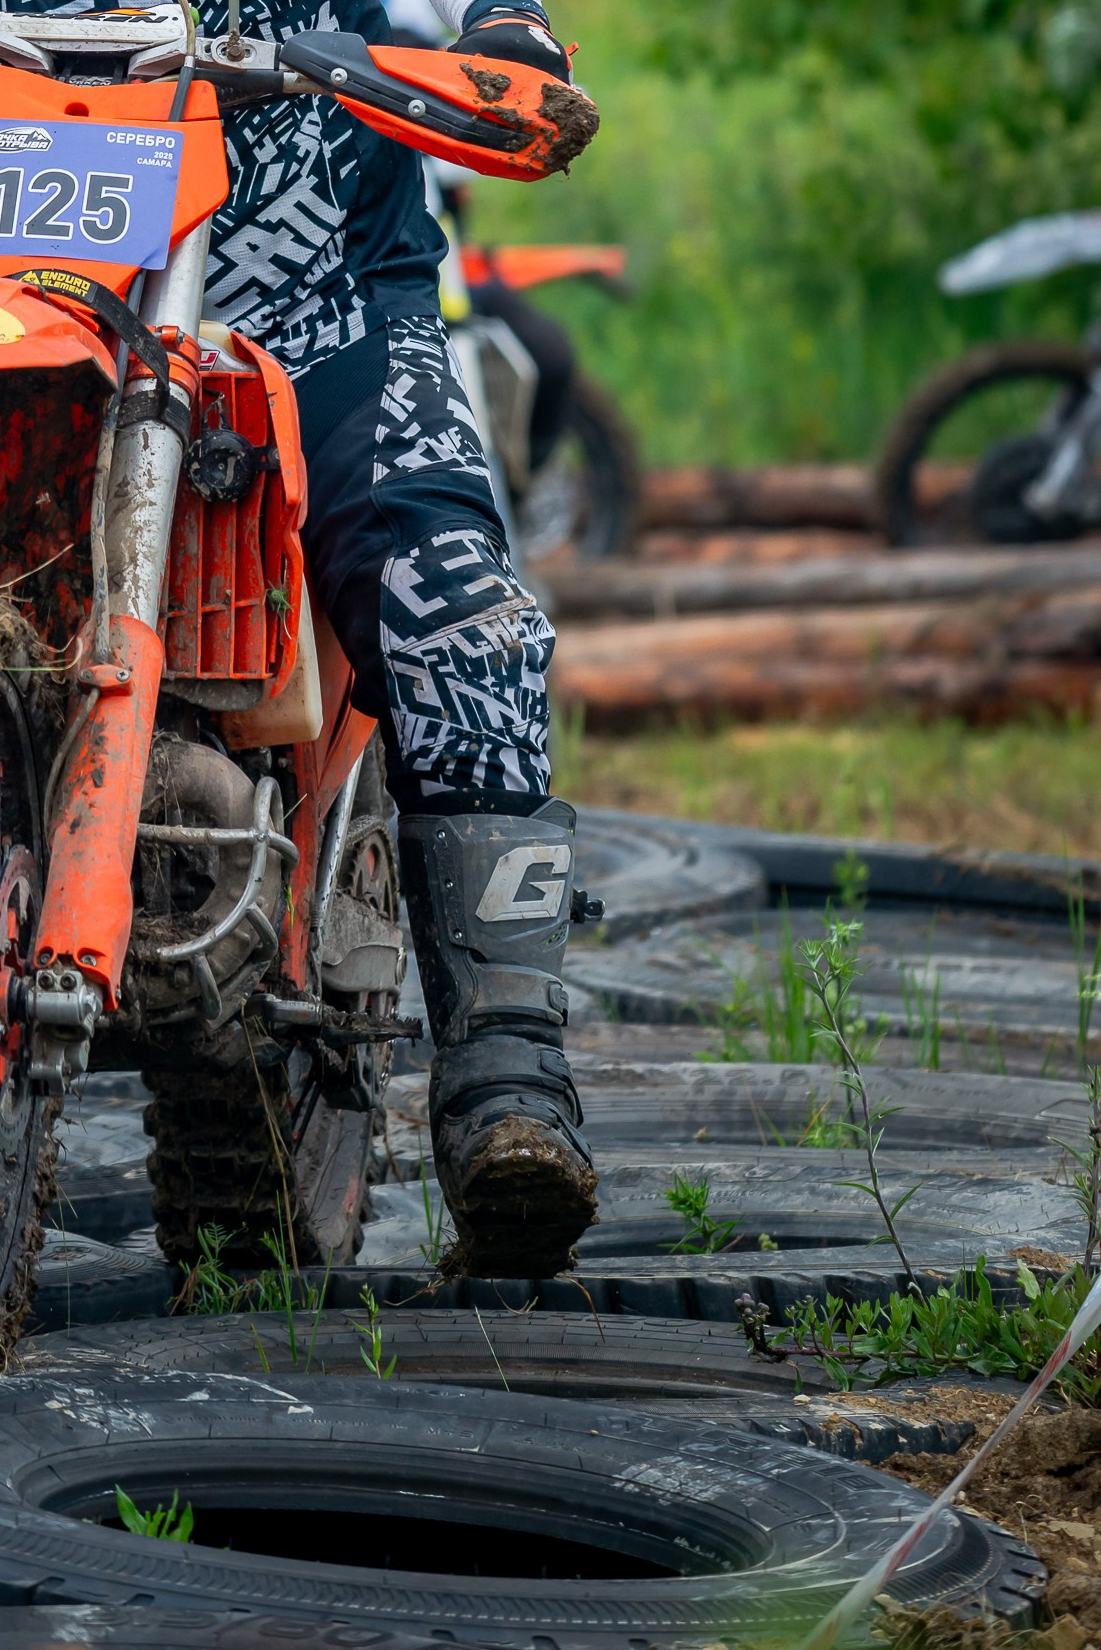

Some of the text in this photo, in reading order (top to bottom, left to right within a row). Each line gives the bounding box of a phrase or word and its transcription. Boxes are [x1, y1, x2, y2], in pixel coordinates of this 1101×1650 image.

[105, 131, 176, 149] СЕРЕБРО
[136, 157, 173, 168] САМАРА
[153, 151, 173, 160] 2025
[40, 270, 91, 290] ENDURO
